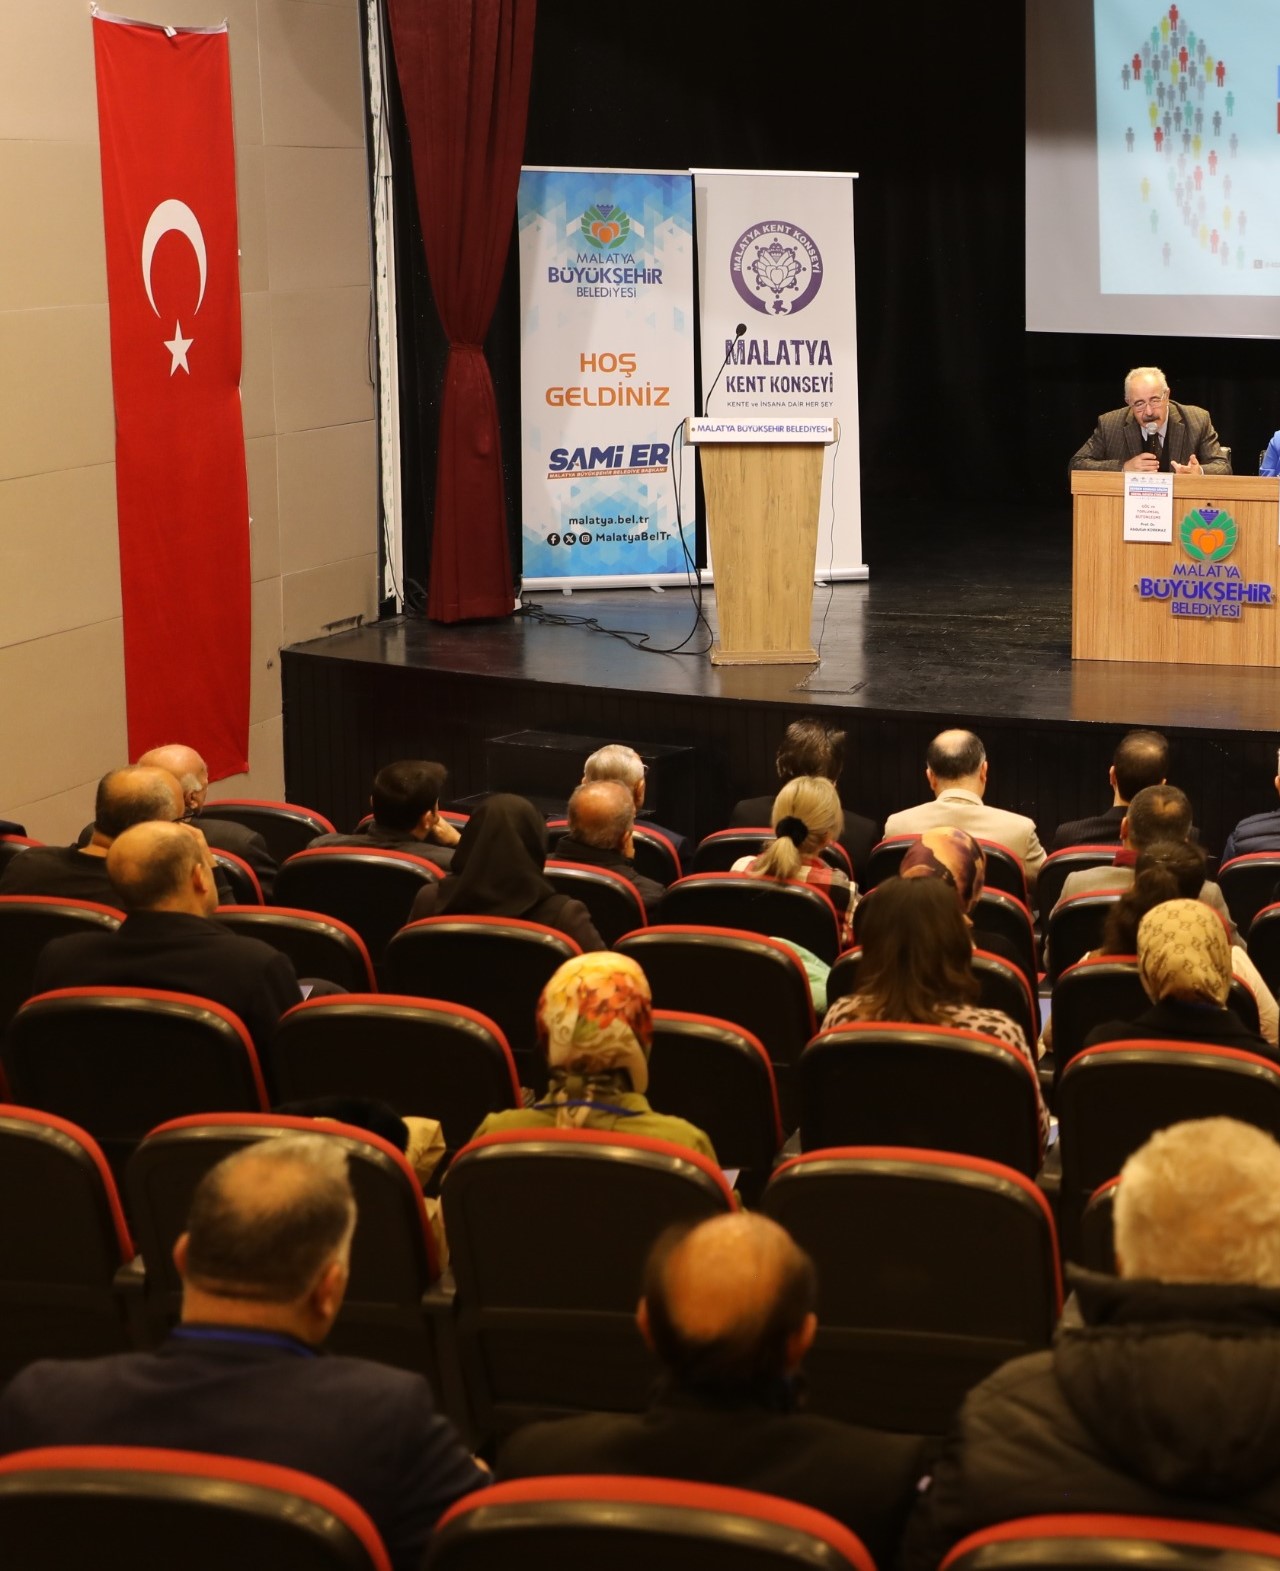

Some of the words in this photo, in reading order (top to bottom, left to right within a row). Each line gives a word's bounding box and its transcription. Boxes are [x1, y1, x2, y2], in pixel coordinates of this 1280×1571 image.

[733, 228, 761, 272] MALATYA
[762, 224, 792, 234] KENT
[792, 230, 822, 273] KONSEYİ
[576, 253, 636, 264] MALATYA
[548, 266, 663, 286] BÜYÜKŞEHİR
[576, 287, 637, 298] BELEDİYESİ
[725, 339, 833, 366] MALATYA
[580, 352, 637, 378] HOŞ
[726, 376, 766, 393] KENT
[770, 372, 834, 393] KONSEYİ
[545, 381, 670, 407] GELDİNİZ
[760, 400, 786, 408] İNSANA
[820, 401, 834, 409] ŞEY
[697, 425, 735, 433] MALATYA
[737, 425, 785, 434] BÜYÜKŞEHİR
[786, 425, 828, 433] BELEDİYESİ
[548, 445, 625, 471] SAMİ
[629, 443, 671, 467] ER
[569, 515, 650, 526] malatya.bel.tr
[595, 531, 671, 543] MalatyaBelTr
[1173, 563, 1240, 578] MALATYA
[1140, 578, 1272, 603] BÜYÜKŞEHİR
[1171, 602, 1240, 617] BELEDİYESİ
